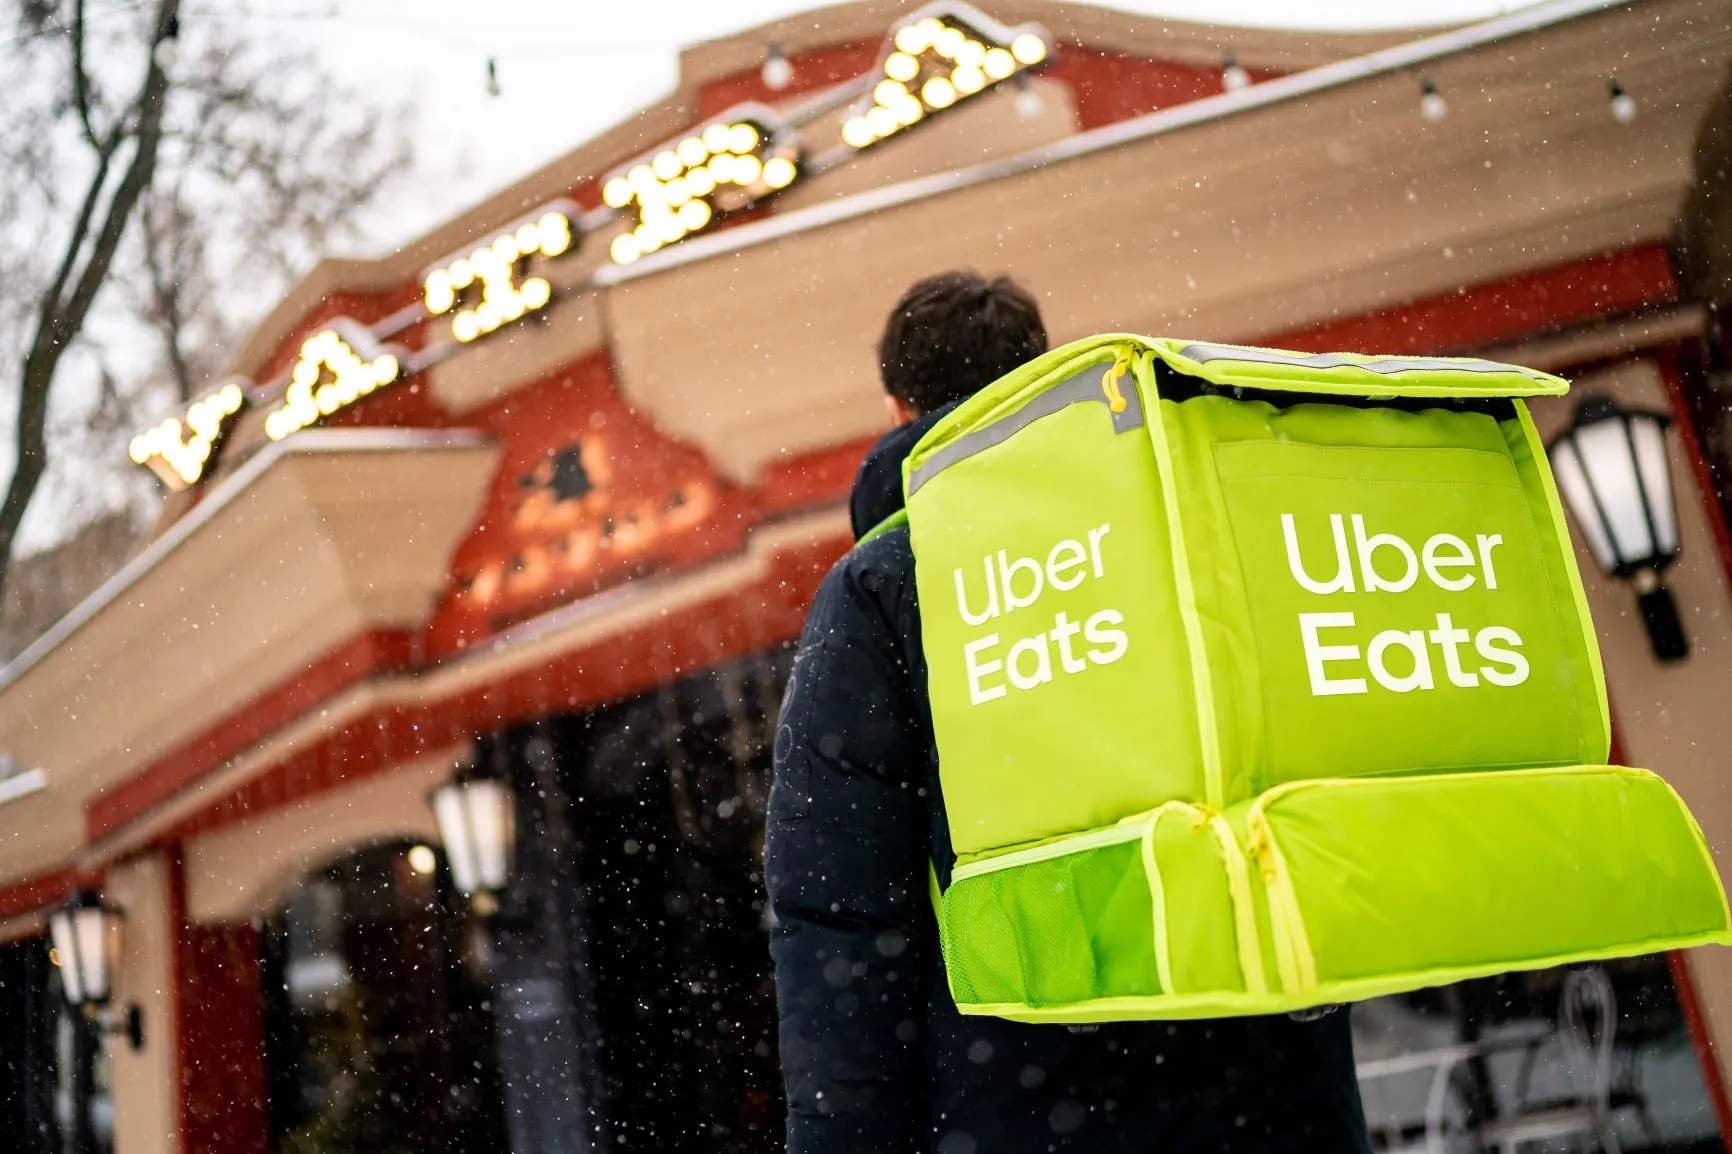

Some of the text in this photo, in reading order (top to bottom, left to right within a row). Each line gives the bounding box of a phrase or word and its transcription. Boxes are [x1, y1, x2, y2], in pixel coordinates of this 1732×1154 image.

[954, 523, 1111, 626] Uber
[1281, 513, 1503, 595] Uber
[964, 608, 1129, 706] Eats
[1299, 612, 1530, 696] Eats
